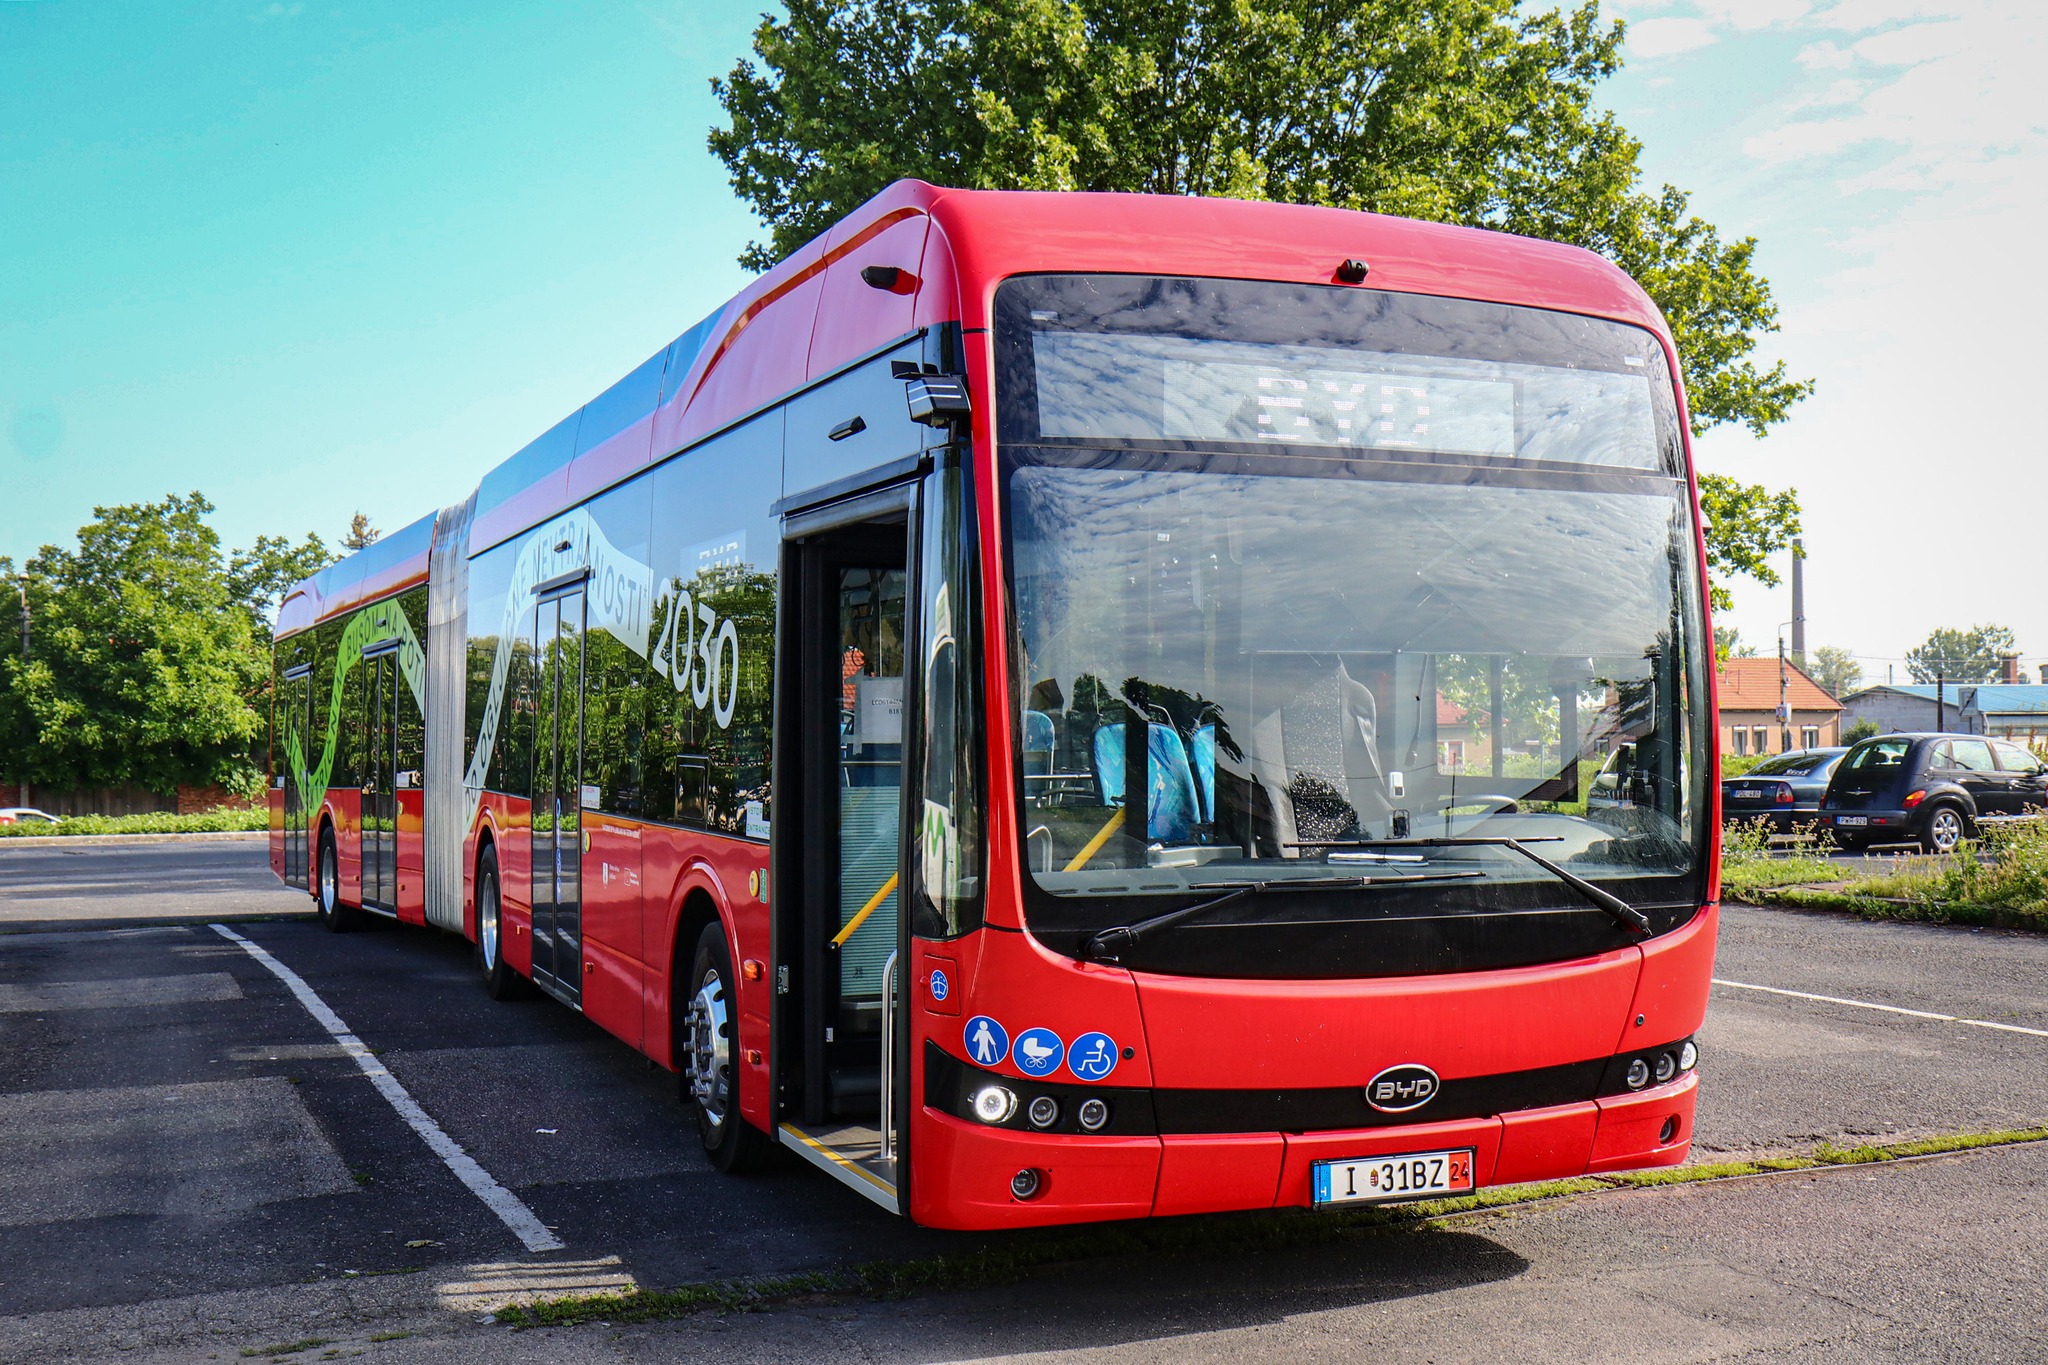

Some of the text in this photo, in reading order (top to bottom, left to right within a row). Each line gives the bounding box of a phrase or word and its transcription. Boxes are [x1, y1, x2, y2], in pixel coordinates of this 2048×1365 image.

[1257, 376, 1430, 447] BYD
[385, 604, 398, 636] NA
[652, 576, 739, 730] 2030
[1375, 1077, 1433, 1100] BYD
[1345, 1165, 1358, 1196] I
[1381, 1158, 1445, 1193] 31BZ
[1450, 1160, 1470, 1182] 24
